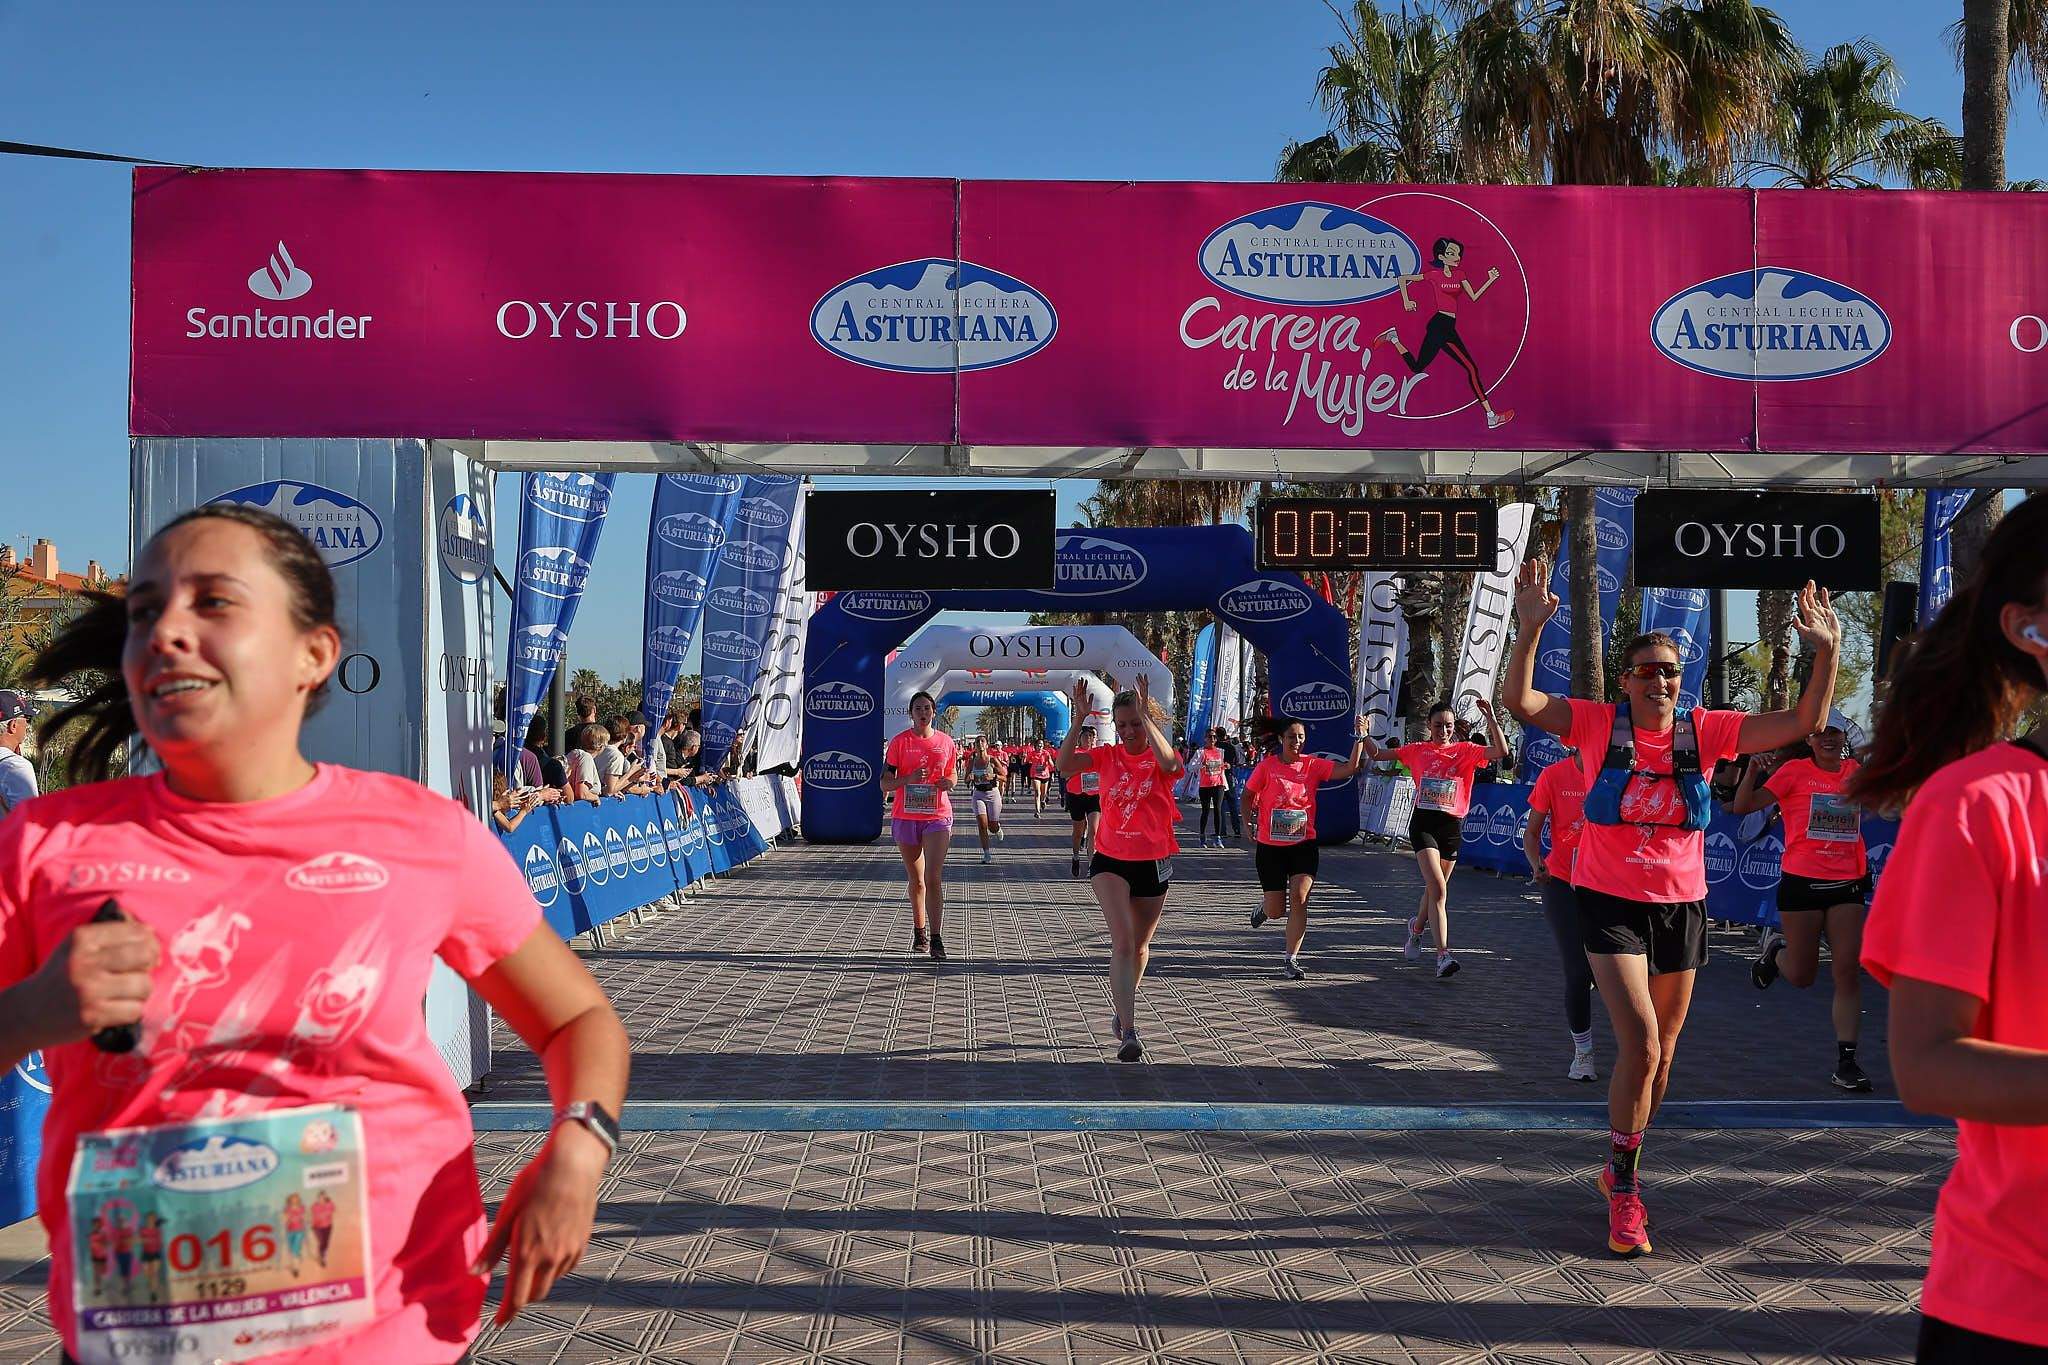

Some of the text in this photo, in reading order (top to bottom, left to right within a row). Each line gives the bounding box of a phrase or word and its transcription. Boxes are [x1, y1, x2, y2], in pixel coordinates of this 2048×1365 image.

[1249, 236, 1397, 249] CENTRAL LECHERA
[1215, 238, 1402, 278] ASTURIANA
[867, 298, 944, 309] CENTRAL
[1706, 306, 1866, 318] CENTRAL LECHERA
[186, 307, 373, 340] Santander
[496, 301, 688, 340] OYSHO
[829, 300, 1039, 342] ASTURIANA
[1179, 296, 1361, 352] Carrera
[1669, 308, 1873, 351] ASTURIANA
[1223, 347, 1430, 437] de la Mujer
[298, 512, 362, 522] LECHERA
[735, 507, 784, 524] STURIANA
[846, 522, 1021, 559] OYSHO
[1274, 510, 1478, 558] 00:37:25
[1673, 522, 1846, 559] OYSHO
[1056, 563, 1137, 581] URIANA
[710, 592, 766, 614] ASTURIANA
[844, 593, 924, 611] ASTURIANA
[1226, 597, 1307, 613] ASTURIANA
[703, 637, 757, 658] ASTURIANA
[968, 634, 1086, 659] OYSHO
[439, 652, 487, 694] OYSHO
[900, 661, 935, 669] OYSHO
[1117, 659, 1153, 669] OYSHO
[703, 687, 749, 702] STURIANA
[808, 696, 870, 711] ASTURIANA
[1285, 698, 1348, 712] ASTURIANA
[884, 707, 912, 716] OYSH
[806, 764, 867, 780] ASTURIANA
[70, 861, 192, 889] OYSHO
[165, 1157, 271, 1181] ASTURIANA
[167, 1224, 276, 1272] 016
[195, 1278, 246, 1298] 1129
[169, 1305, 188, 1323] DE
[189, 1303, 210, 1320] LA
[214, 1297, 268, 1317] MUJER
[279, 1283, 352, 1308] VALENCIA
